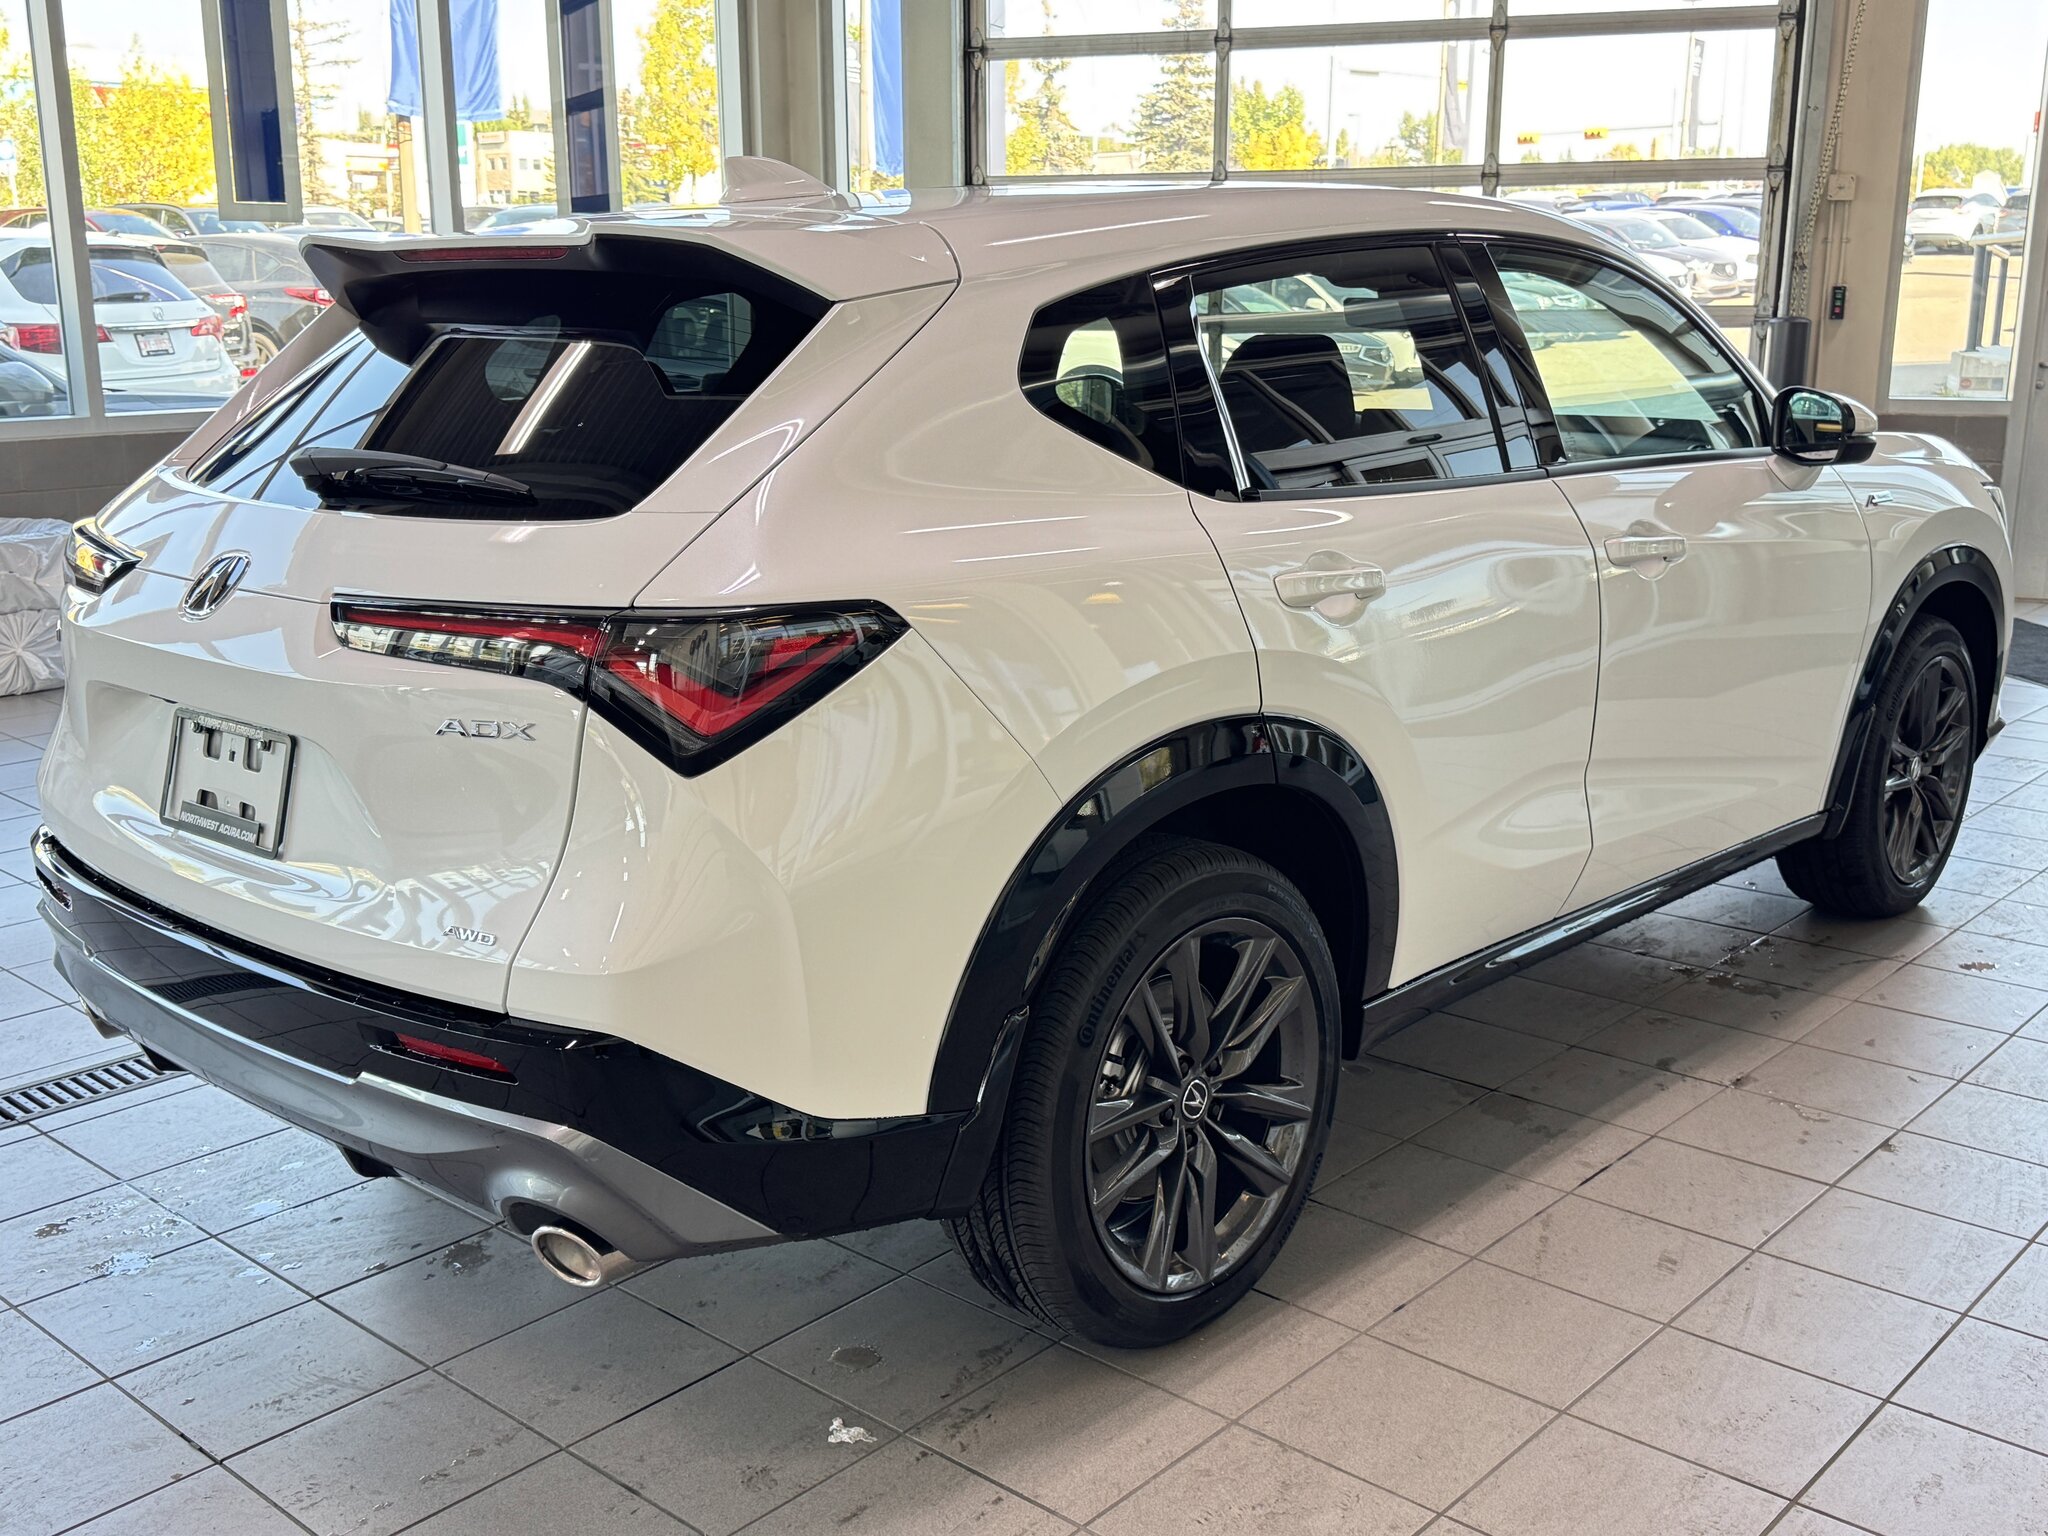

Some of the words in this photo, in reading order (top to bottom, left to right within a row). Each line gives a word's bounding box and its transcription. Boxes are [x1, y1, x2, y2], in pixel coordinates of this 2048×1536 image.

[220, 721, 236, 732] AUTO
[434, 719, 537, 741] ADX
[180, 811, 219, 832] NORTHWEST
[218, 823, 257, 844] ACURA.COM
[442, 925, 498, 946] AWD
[1077, 940, 1140, 1048] Continental
